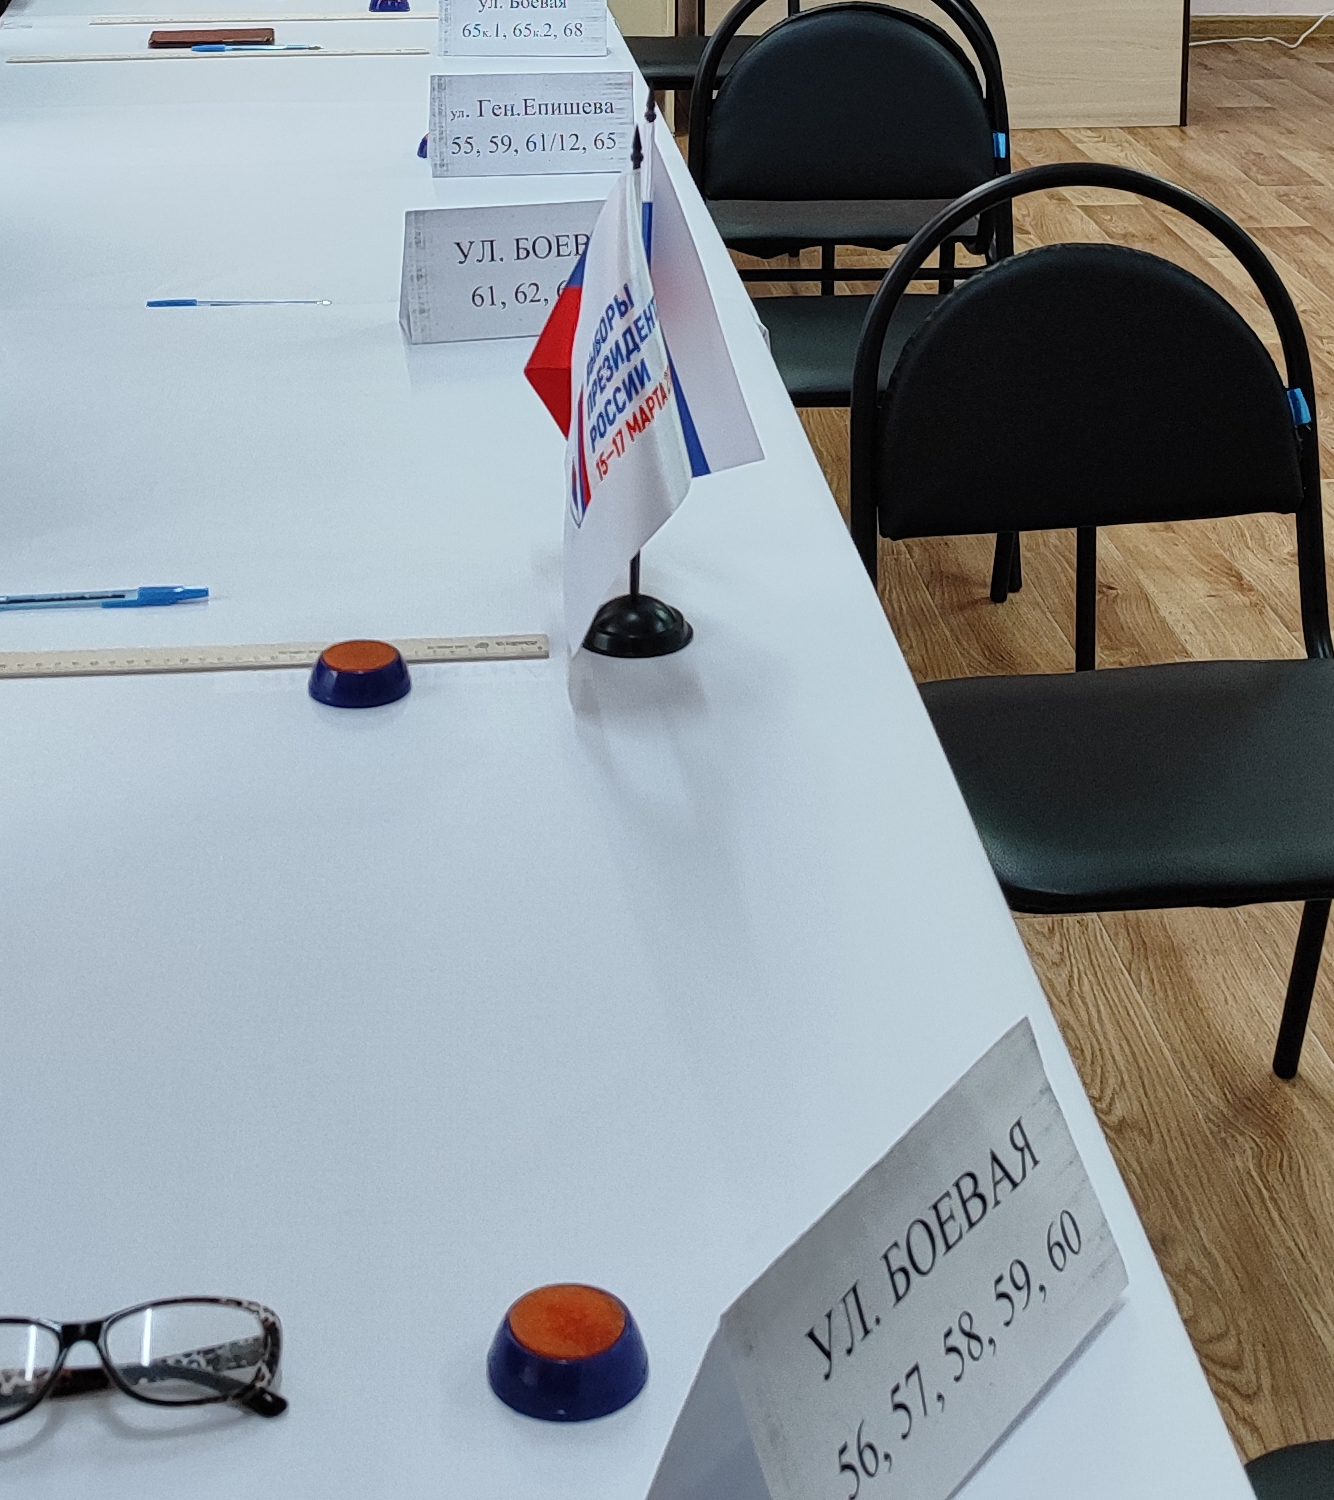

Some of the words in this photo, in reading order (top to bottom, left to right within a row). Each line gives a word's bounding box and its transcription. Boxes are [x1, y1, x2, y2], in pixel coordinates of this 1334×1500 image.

[563, 22, 584, 38] 68
[450, 109, 470, 122] ул.
[476, 98, 616, 118] Ген.Епишева
[450, 135, 481, 157] 55,
[488, 134, 519, 156] 59,
[525, 131, 587, 154] 61/12,
[593, 131, 618, 150] 65
[453, 238, 504, 265] УЛ.
[513, 232, 591, 262] БОЕВ
[471, 284, 507, 310] 61,
[514, 281, 549, 306] 62,
[589, 356, 652, 454] РОССИИ
[625, 380, 669, 443] МАРТА
[803, 1279, 882, 1381] УЛ.
[878, 1115, 1041, 1307] БОЕВАЯ
[836, 1418, 893, 1500] 56,
[889, 1361, 946, 1440] 57,
[942, 1309, 998, 1383] 58,
[992, 1258, 1048, 1328] 59,
[1044, 1208, 1083, 1273] 60
